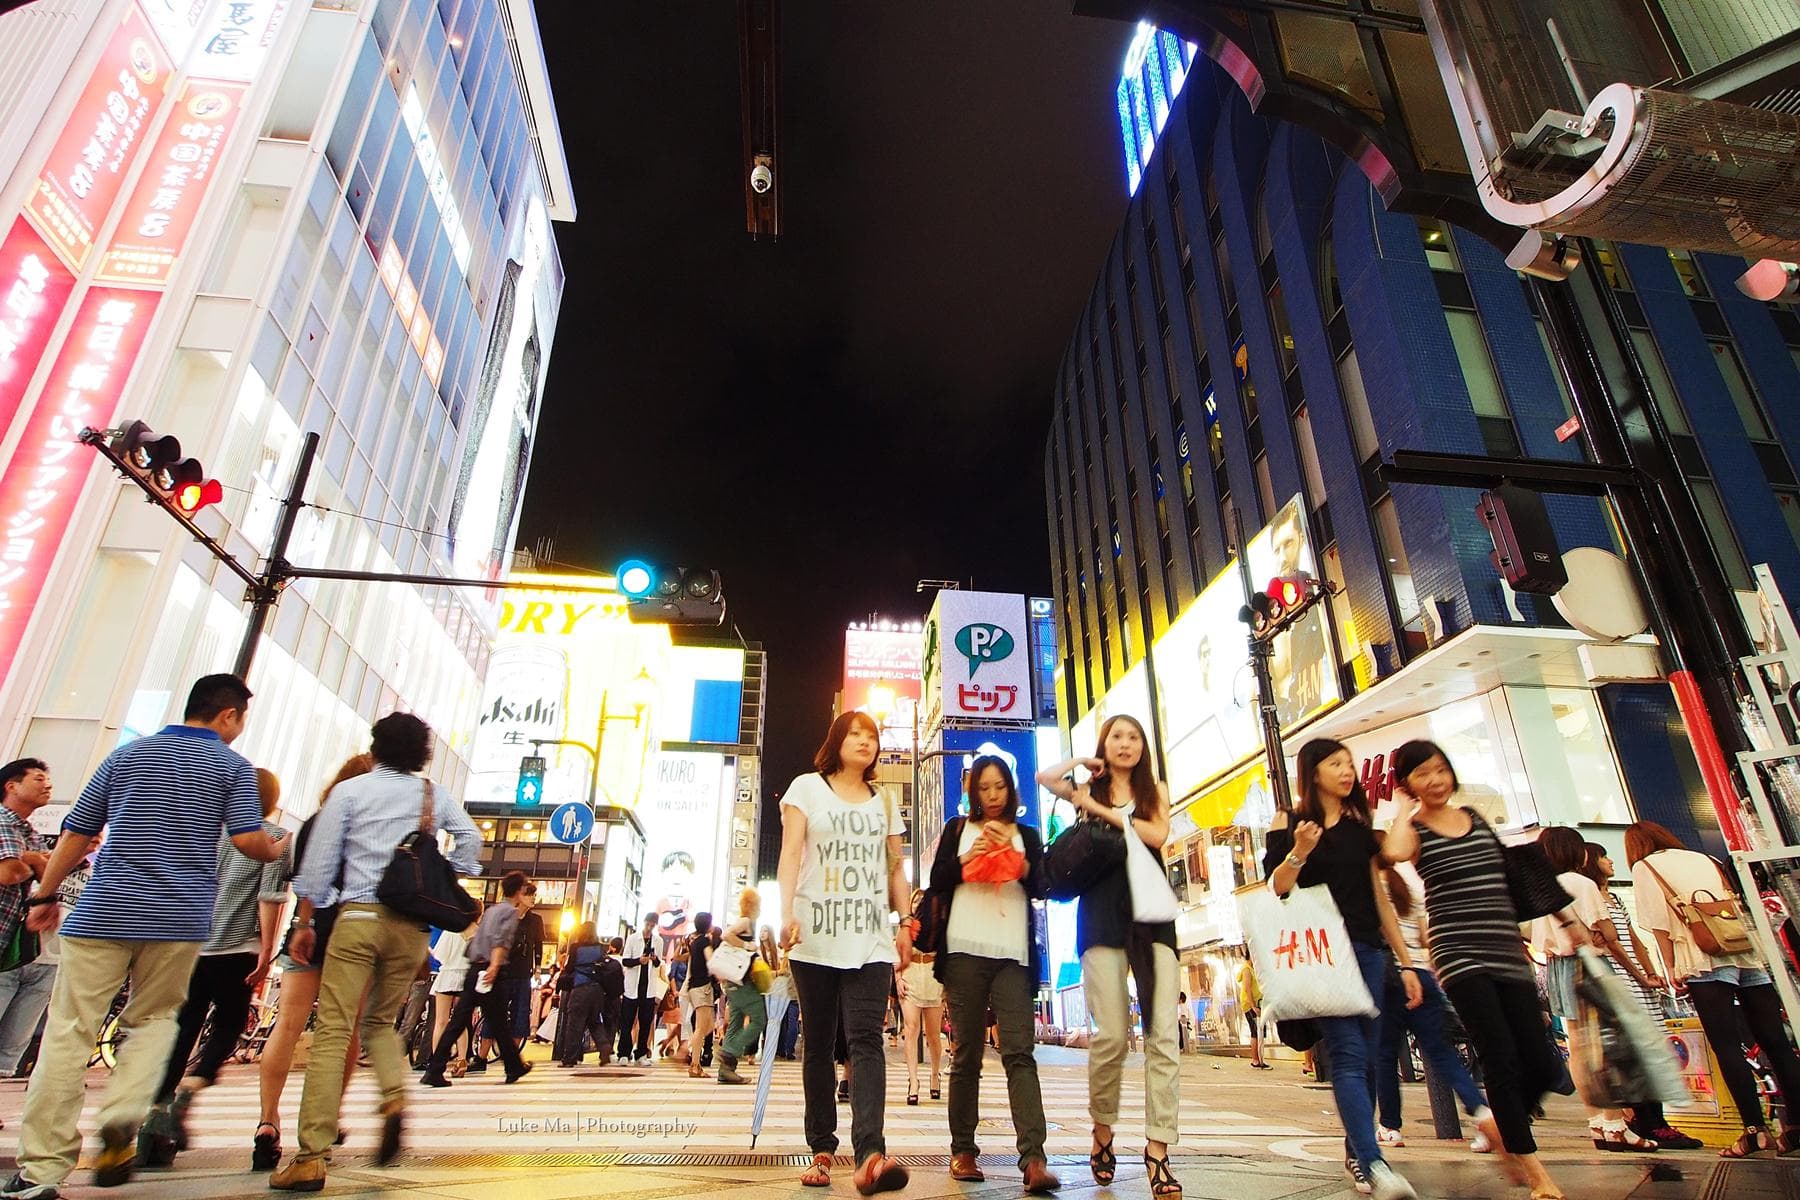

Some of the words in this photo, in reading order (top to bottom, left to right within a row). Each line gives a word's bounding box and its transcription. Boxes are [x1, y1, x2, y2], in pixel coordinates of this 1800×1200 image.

[480, 695, 556, 726] Asahi
[958, 683, 1018, 713] ピップ
[502, 730, 525, 745] 生
[1272, 928, 1335, 969] H&M
